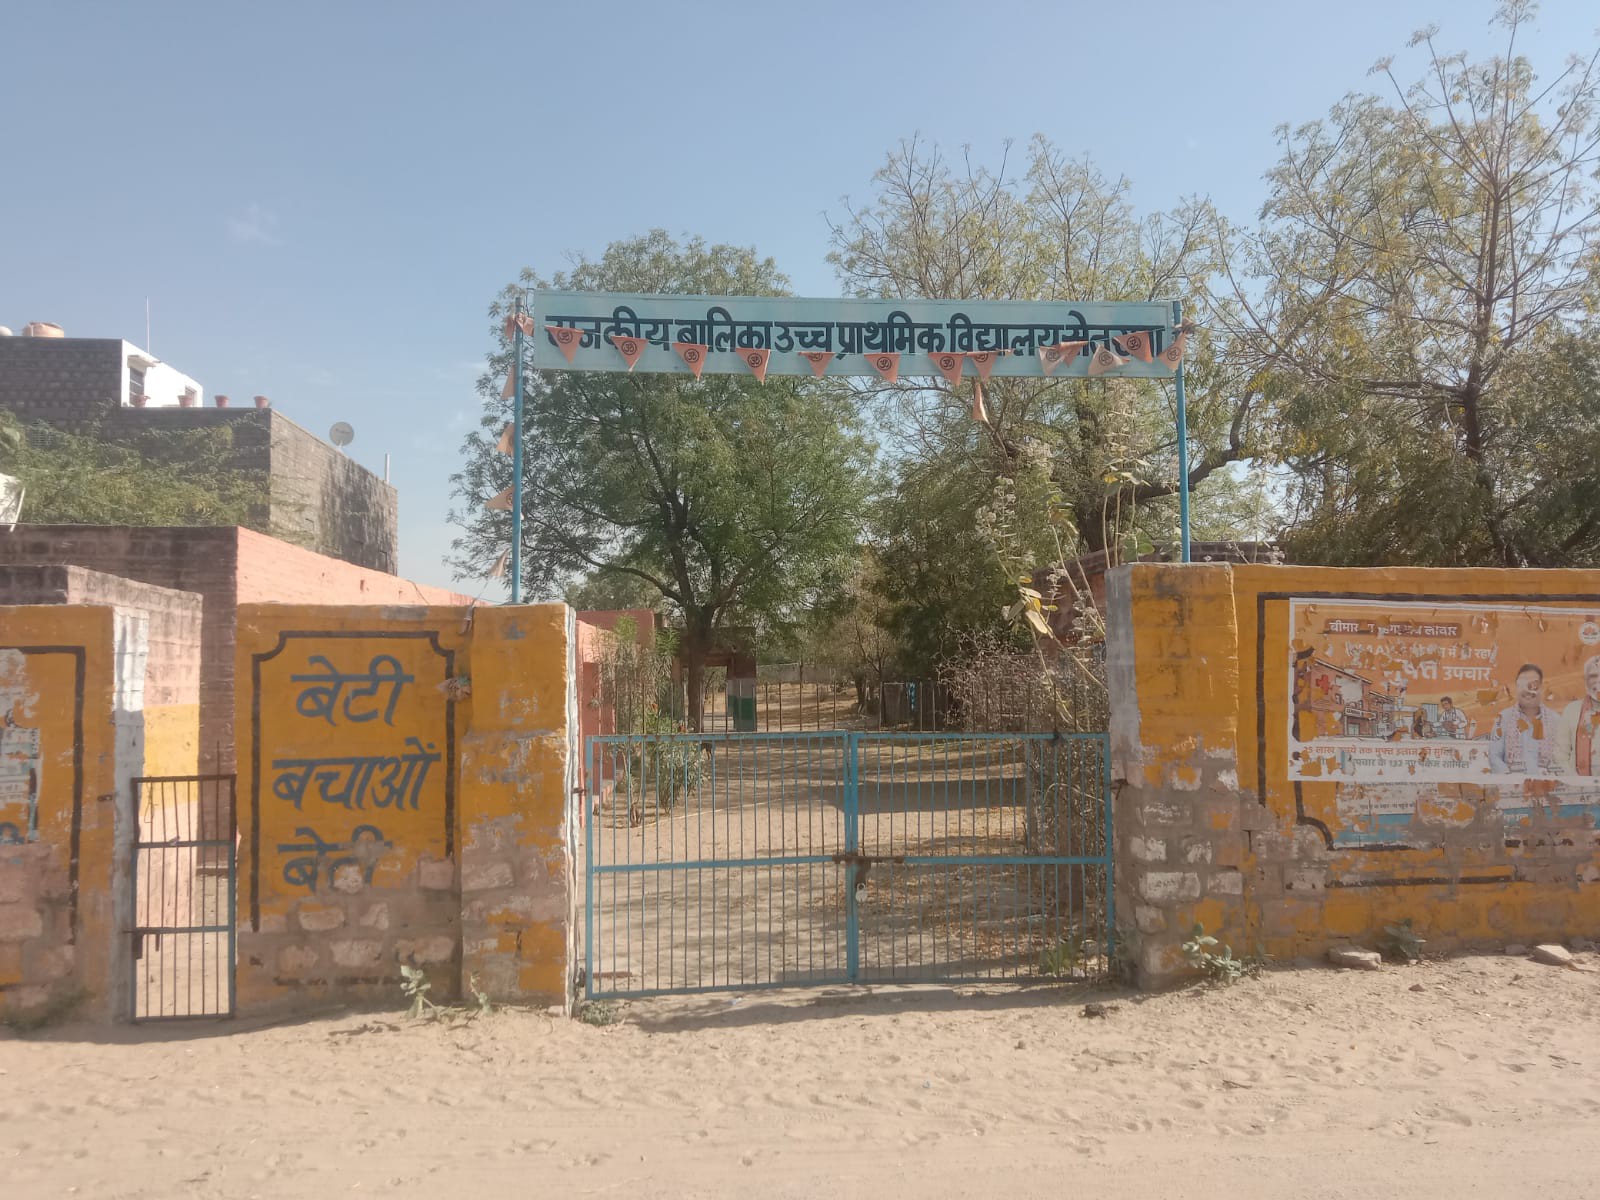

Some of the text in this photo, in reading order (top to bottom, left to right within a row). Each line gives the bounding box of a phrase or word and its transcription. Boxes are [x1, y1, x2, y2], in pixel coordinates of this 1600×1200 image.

[545, 306, 673, 351] रजकीय
[675, 306, 773, 353] बालिका
[774, 321, 835, 353] उच्च
[836, 311, 945, 360] प्राथमिक
[947, 313, 1063, 358] विद्यालय
[290, 654, 415, 727] बेटी
[1443, 666, 1492, 681] उपचार
